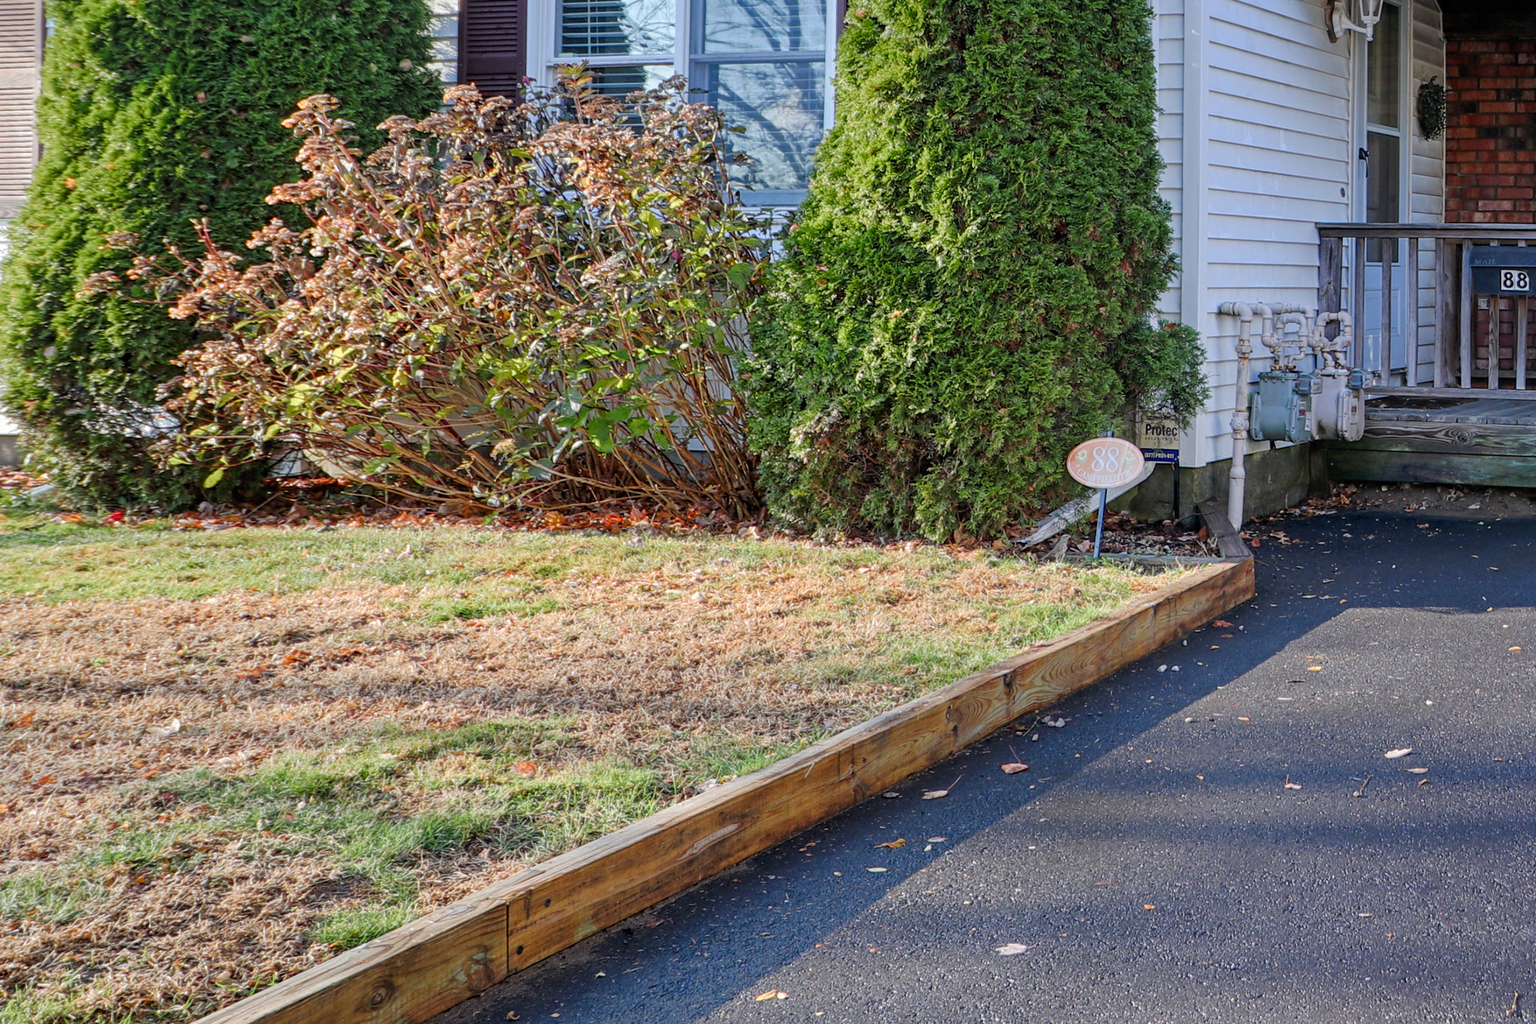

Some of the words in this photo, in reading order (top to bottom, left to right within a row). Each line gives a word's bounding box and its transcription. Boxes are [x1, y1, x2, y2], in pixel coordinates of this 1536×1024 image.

[1503, 271, 1528, 289] 88
[1145, 423, 1178, 436] Protec
[1091, 446, 1119, 472] 88
[1076, 468, 1120, 483] CAMPFIELD
[1120, 469, 1132, 479] DR
